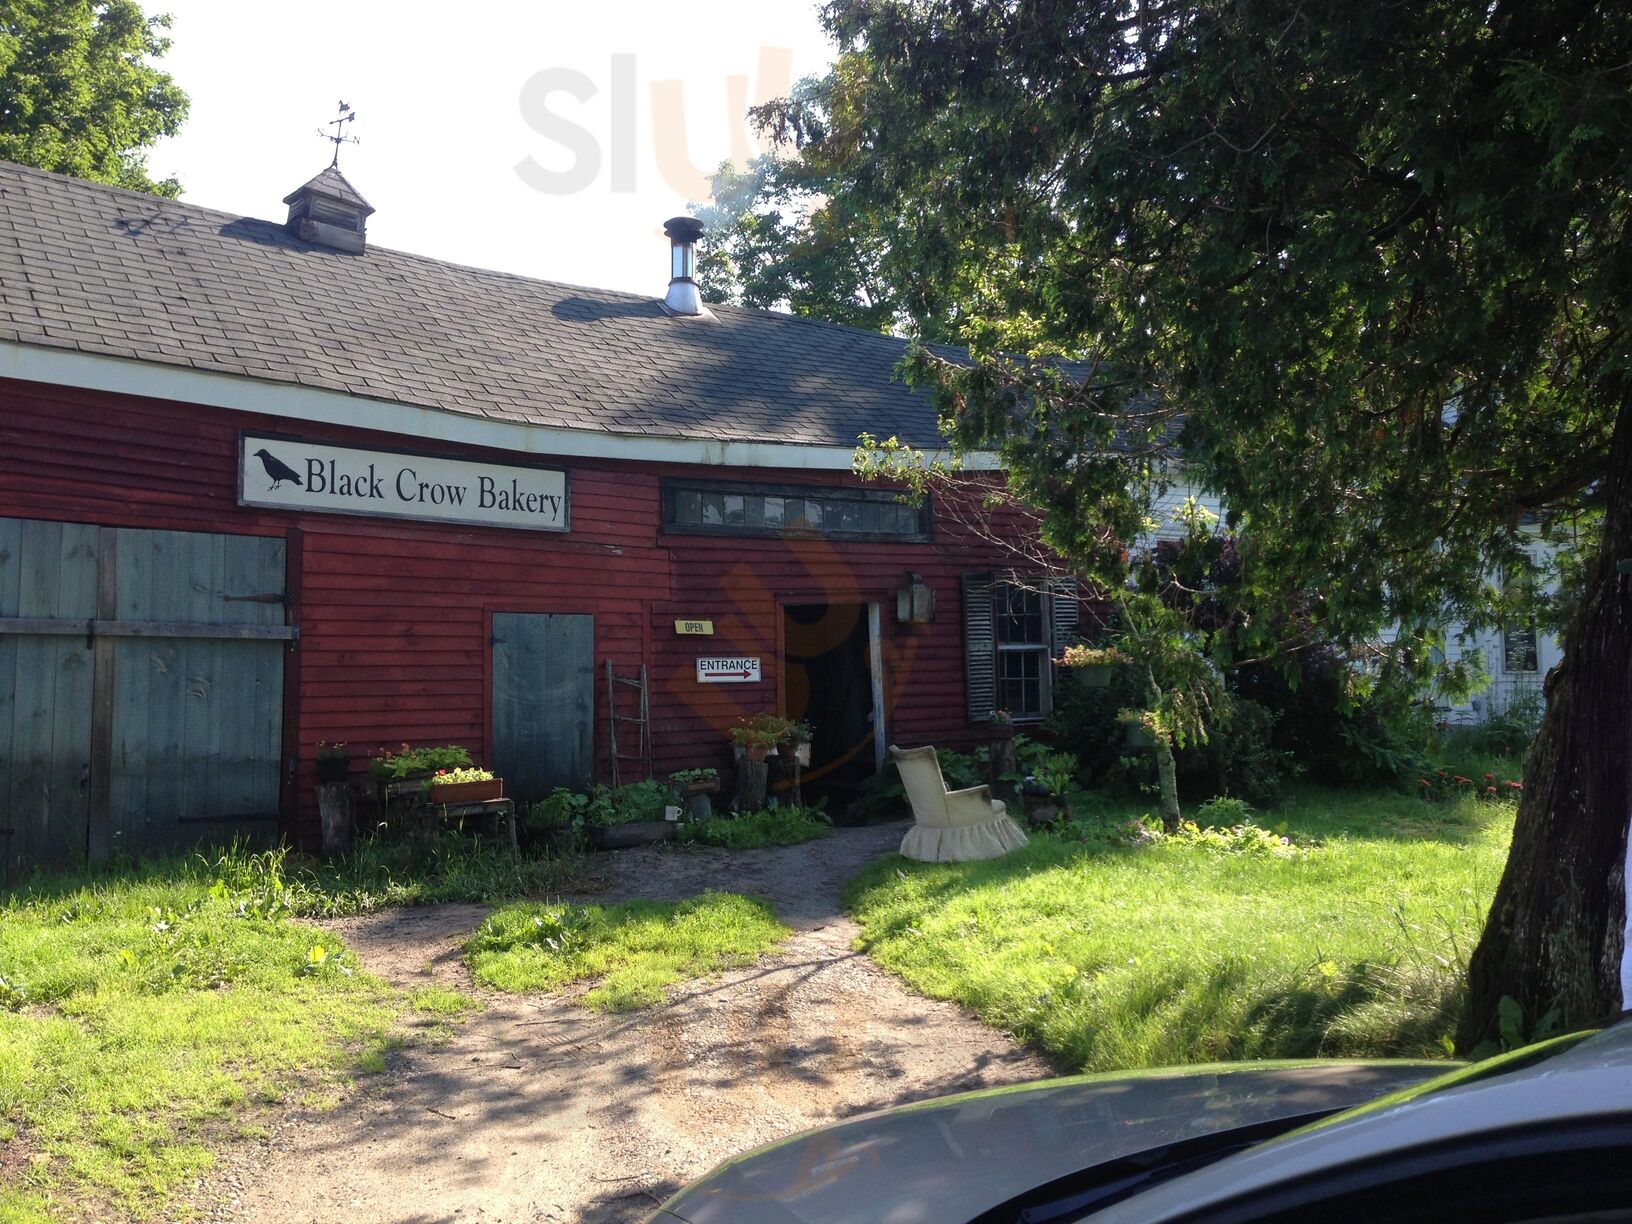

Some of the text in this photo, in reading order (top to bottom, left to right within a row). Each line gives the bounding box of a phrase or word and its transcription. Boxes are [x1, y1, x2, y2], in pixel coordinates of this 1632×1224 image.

[304, 458, 562, 522] Black Crow Bakery
[685, 622, 704, 633] OPEN
[700, 660, 758, 671] ENTRANCE
